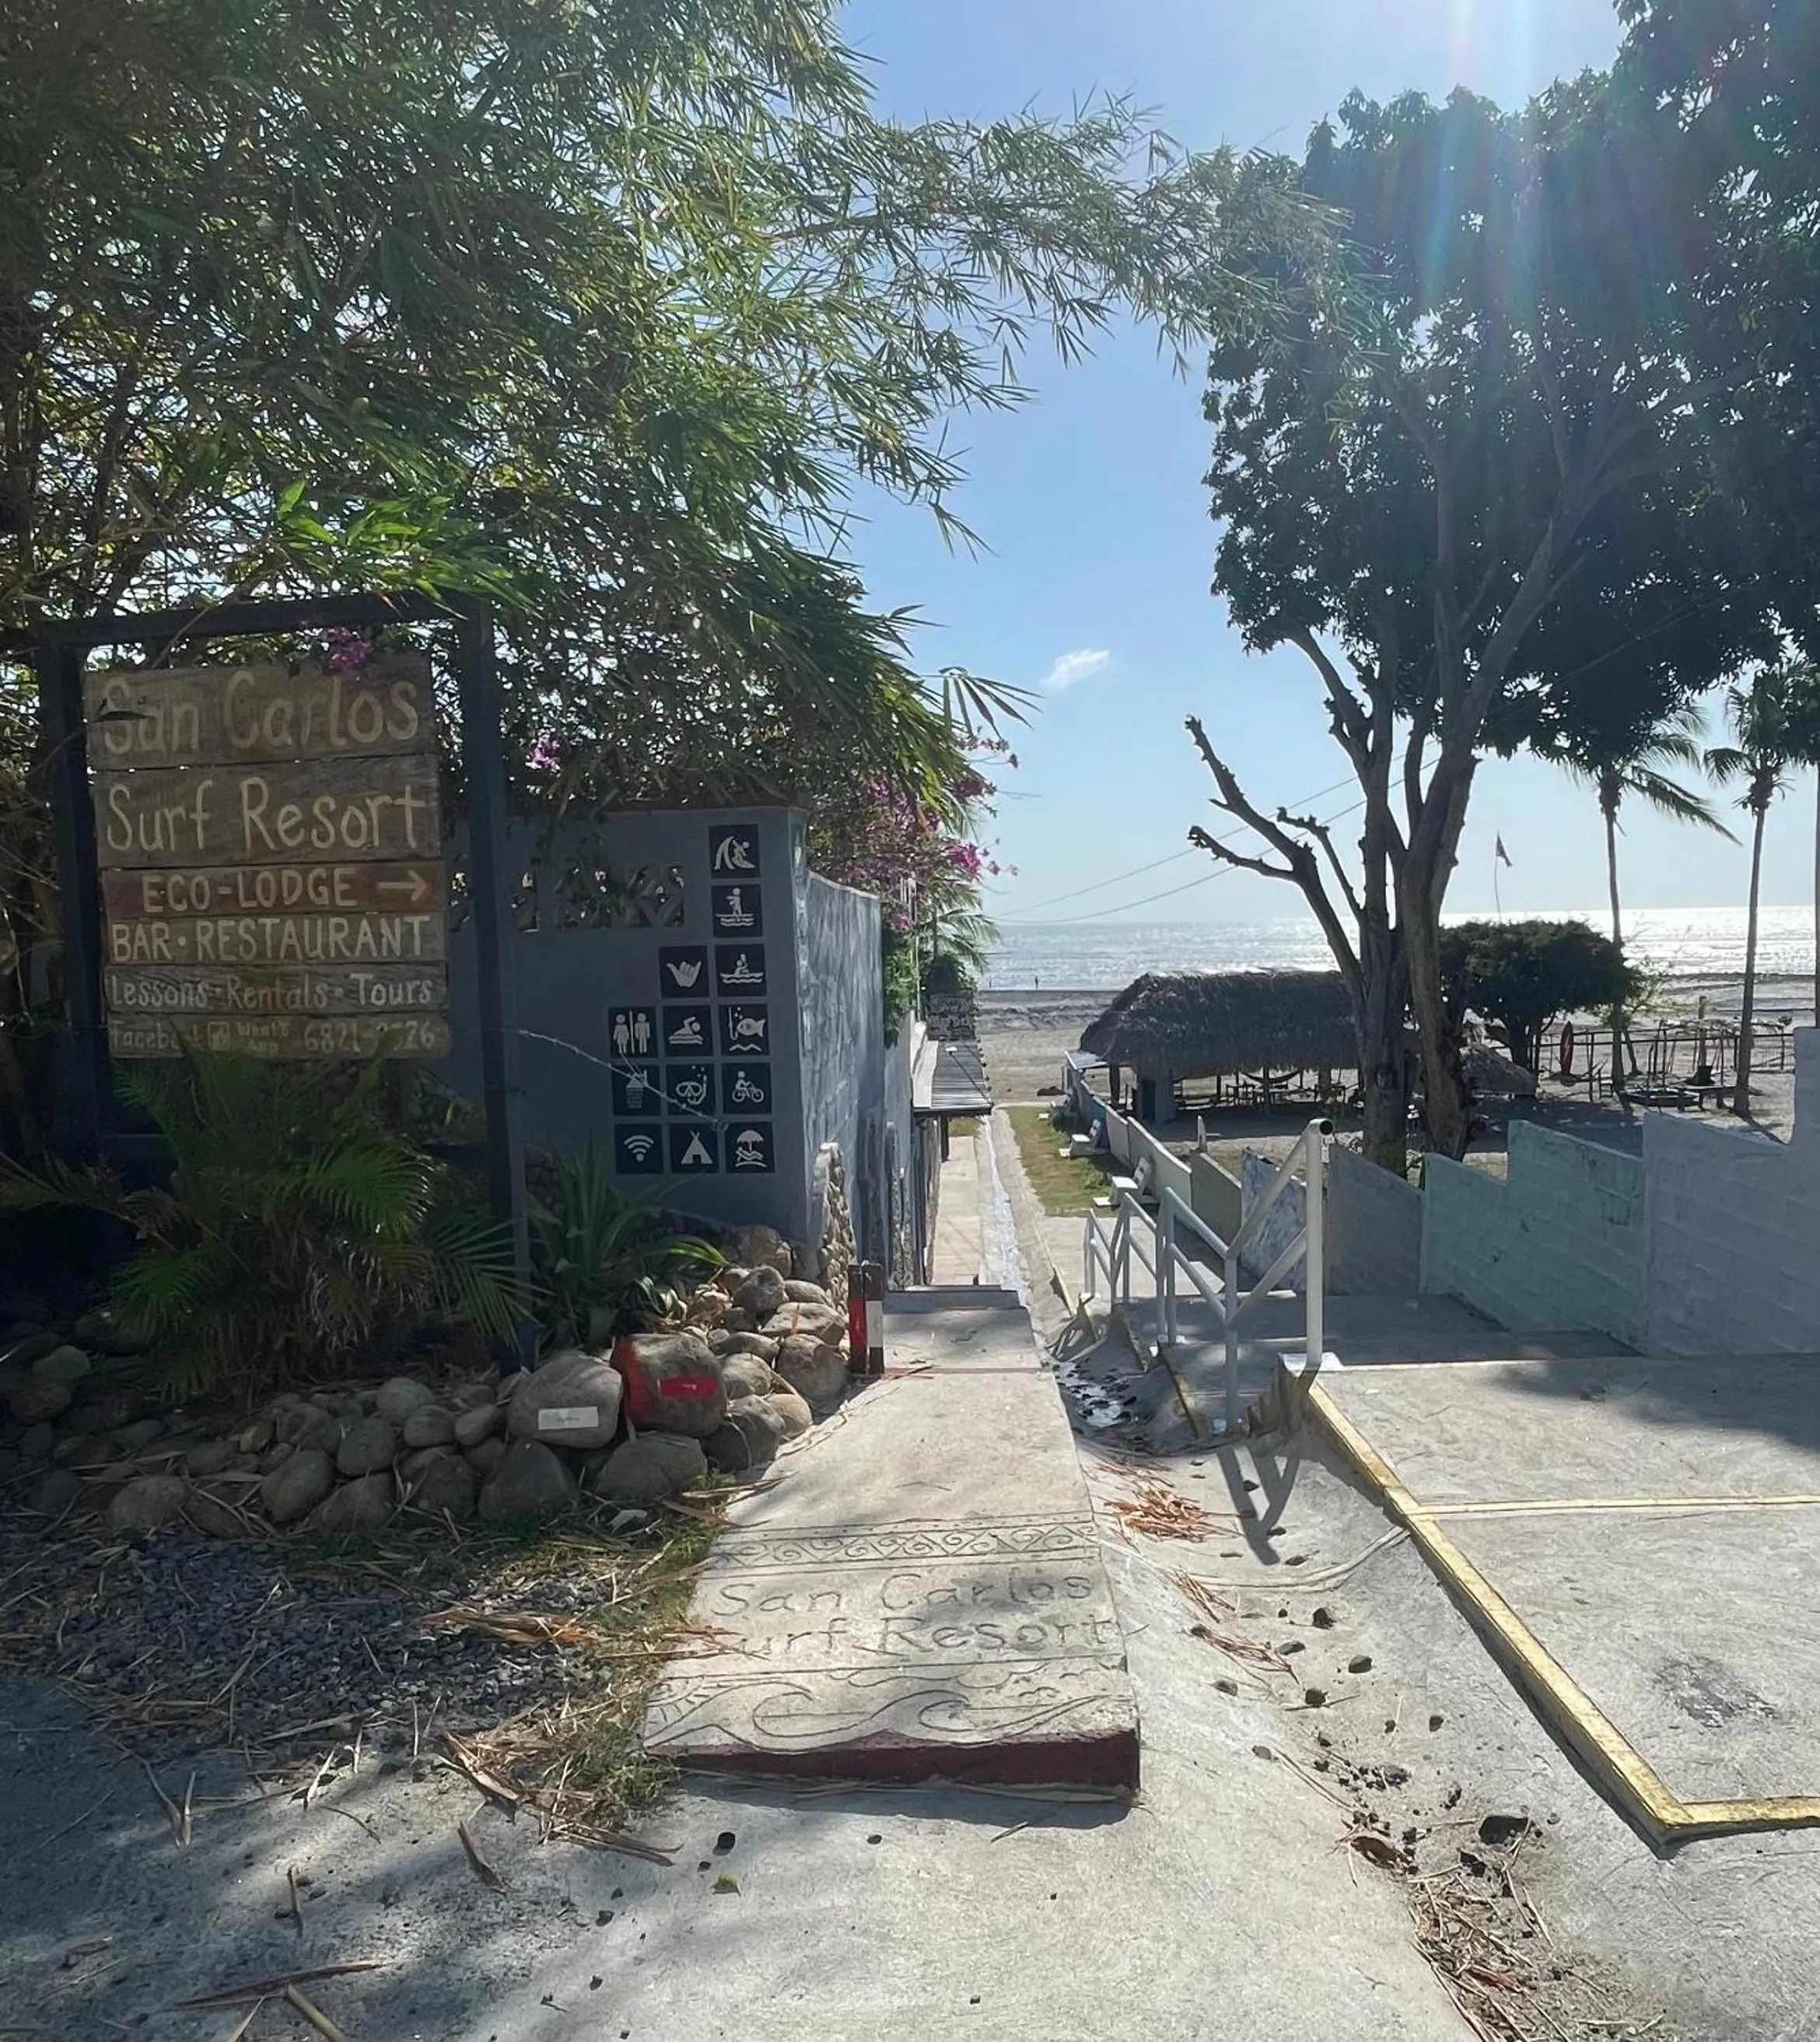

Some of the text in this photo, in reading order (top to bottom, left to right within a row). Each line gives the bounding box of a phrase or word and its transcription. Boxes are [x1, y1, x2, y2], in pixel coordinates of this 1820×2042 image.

[103, 670, 419, 755] San Carlos
[107, 777, 428, 852] Surf Resort
[349, 973, 432, 1006] Tours
[711, 1572, 1090, 1616] San Carlos
[739, 1614, 1112, 1656] urf Resort
